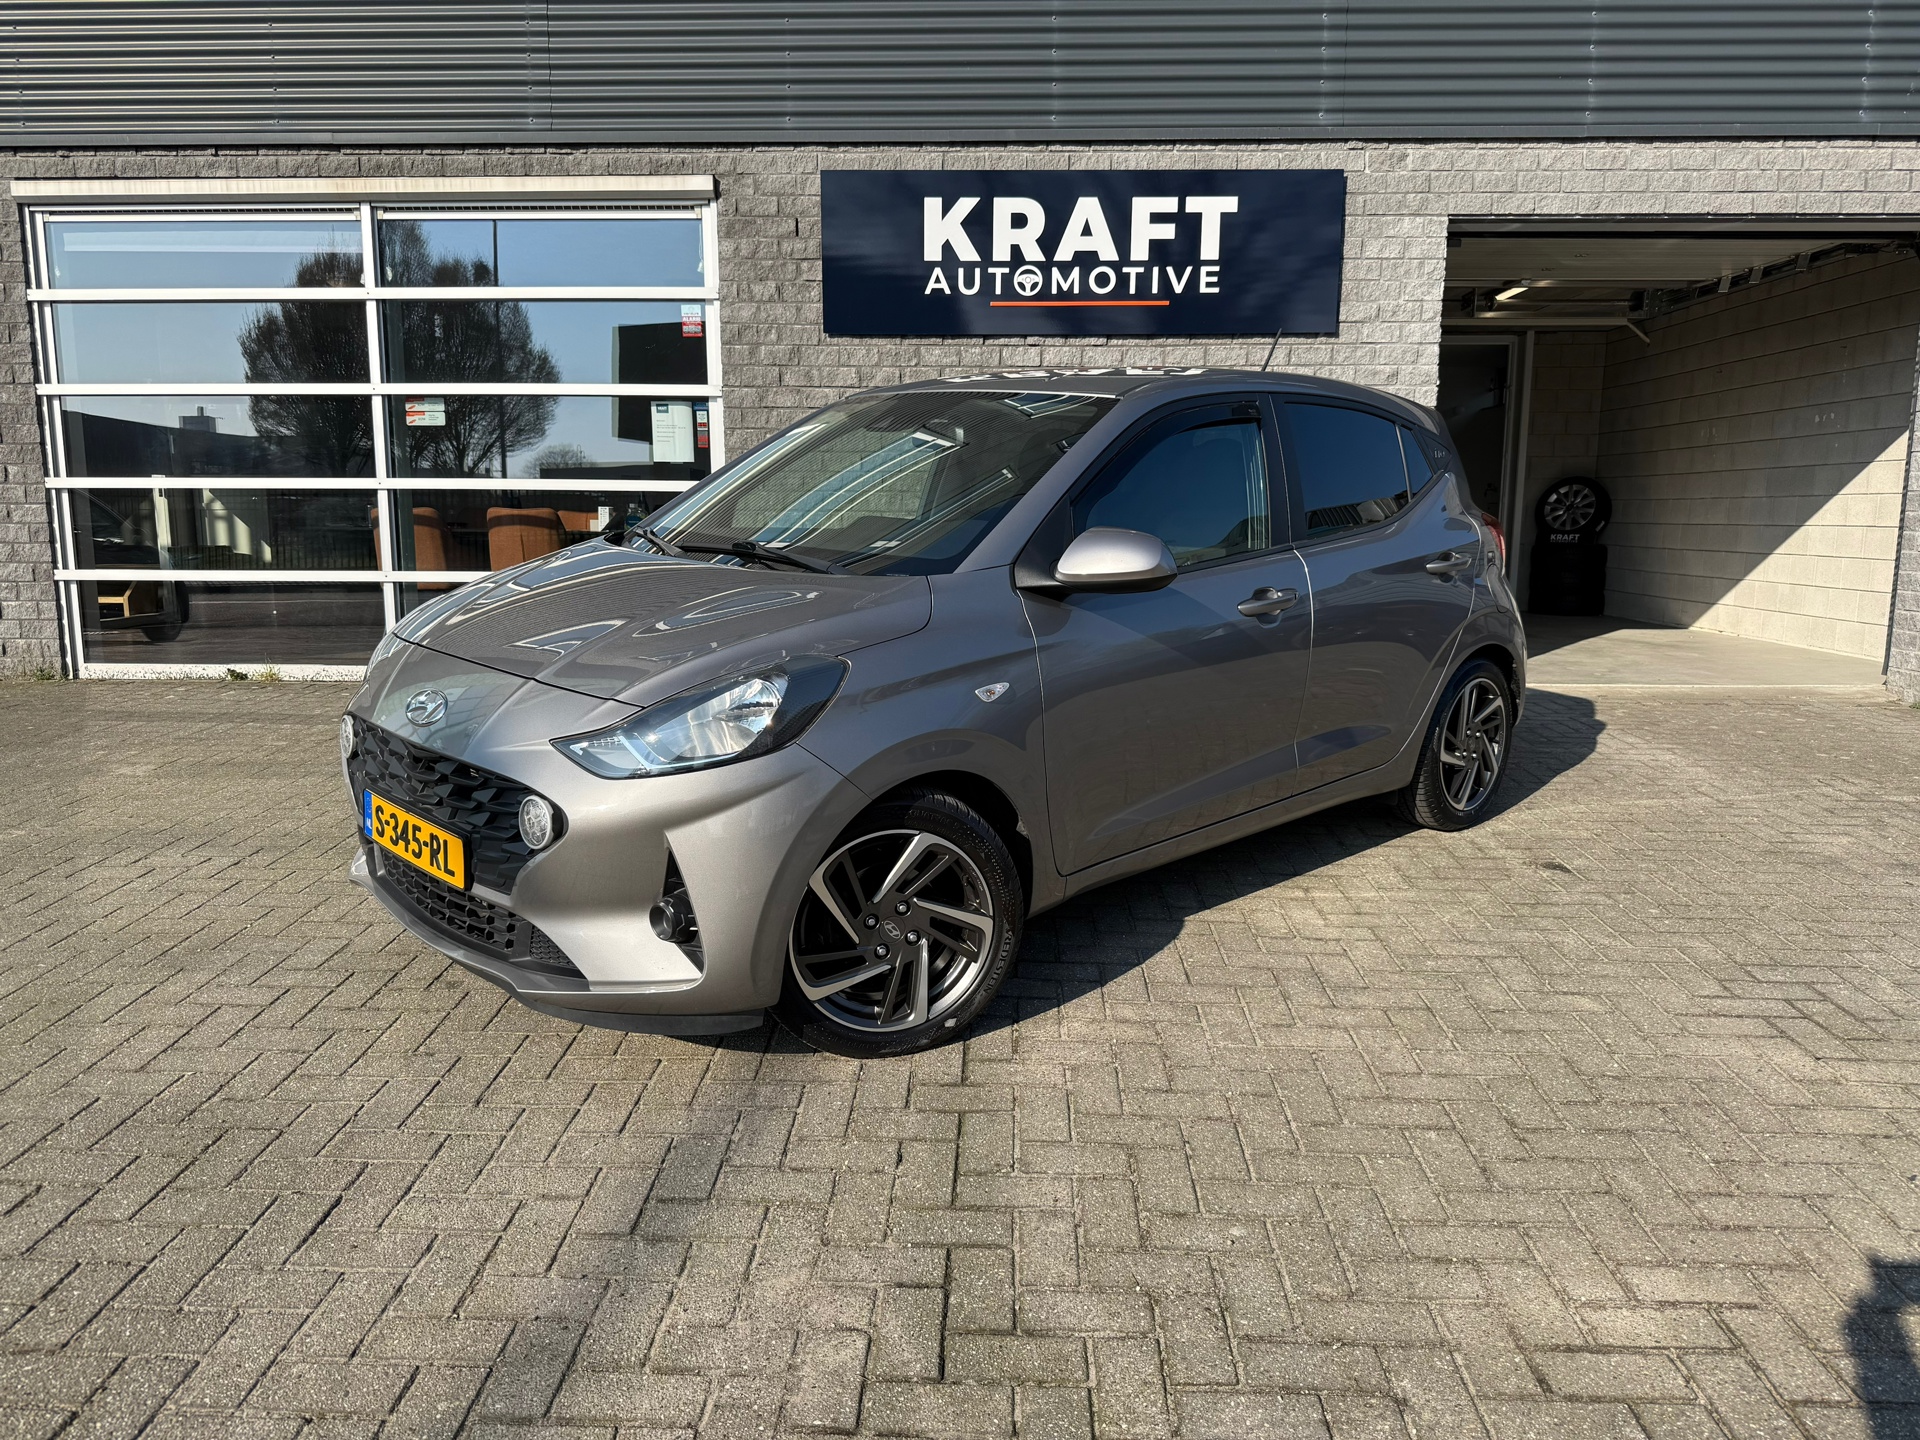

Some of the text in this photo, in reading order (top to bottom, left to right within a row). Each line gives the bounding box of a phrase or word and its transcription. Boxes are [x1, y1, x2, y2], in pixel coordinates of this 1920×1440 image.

[923, 196, 1239, 262] KRAFT
[924, 264, 1220, 296] AUTOMOTIVE
[1550, 533, 1580, 541] KRAFT
[375, 805, 455, 877] S-345-RL
